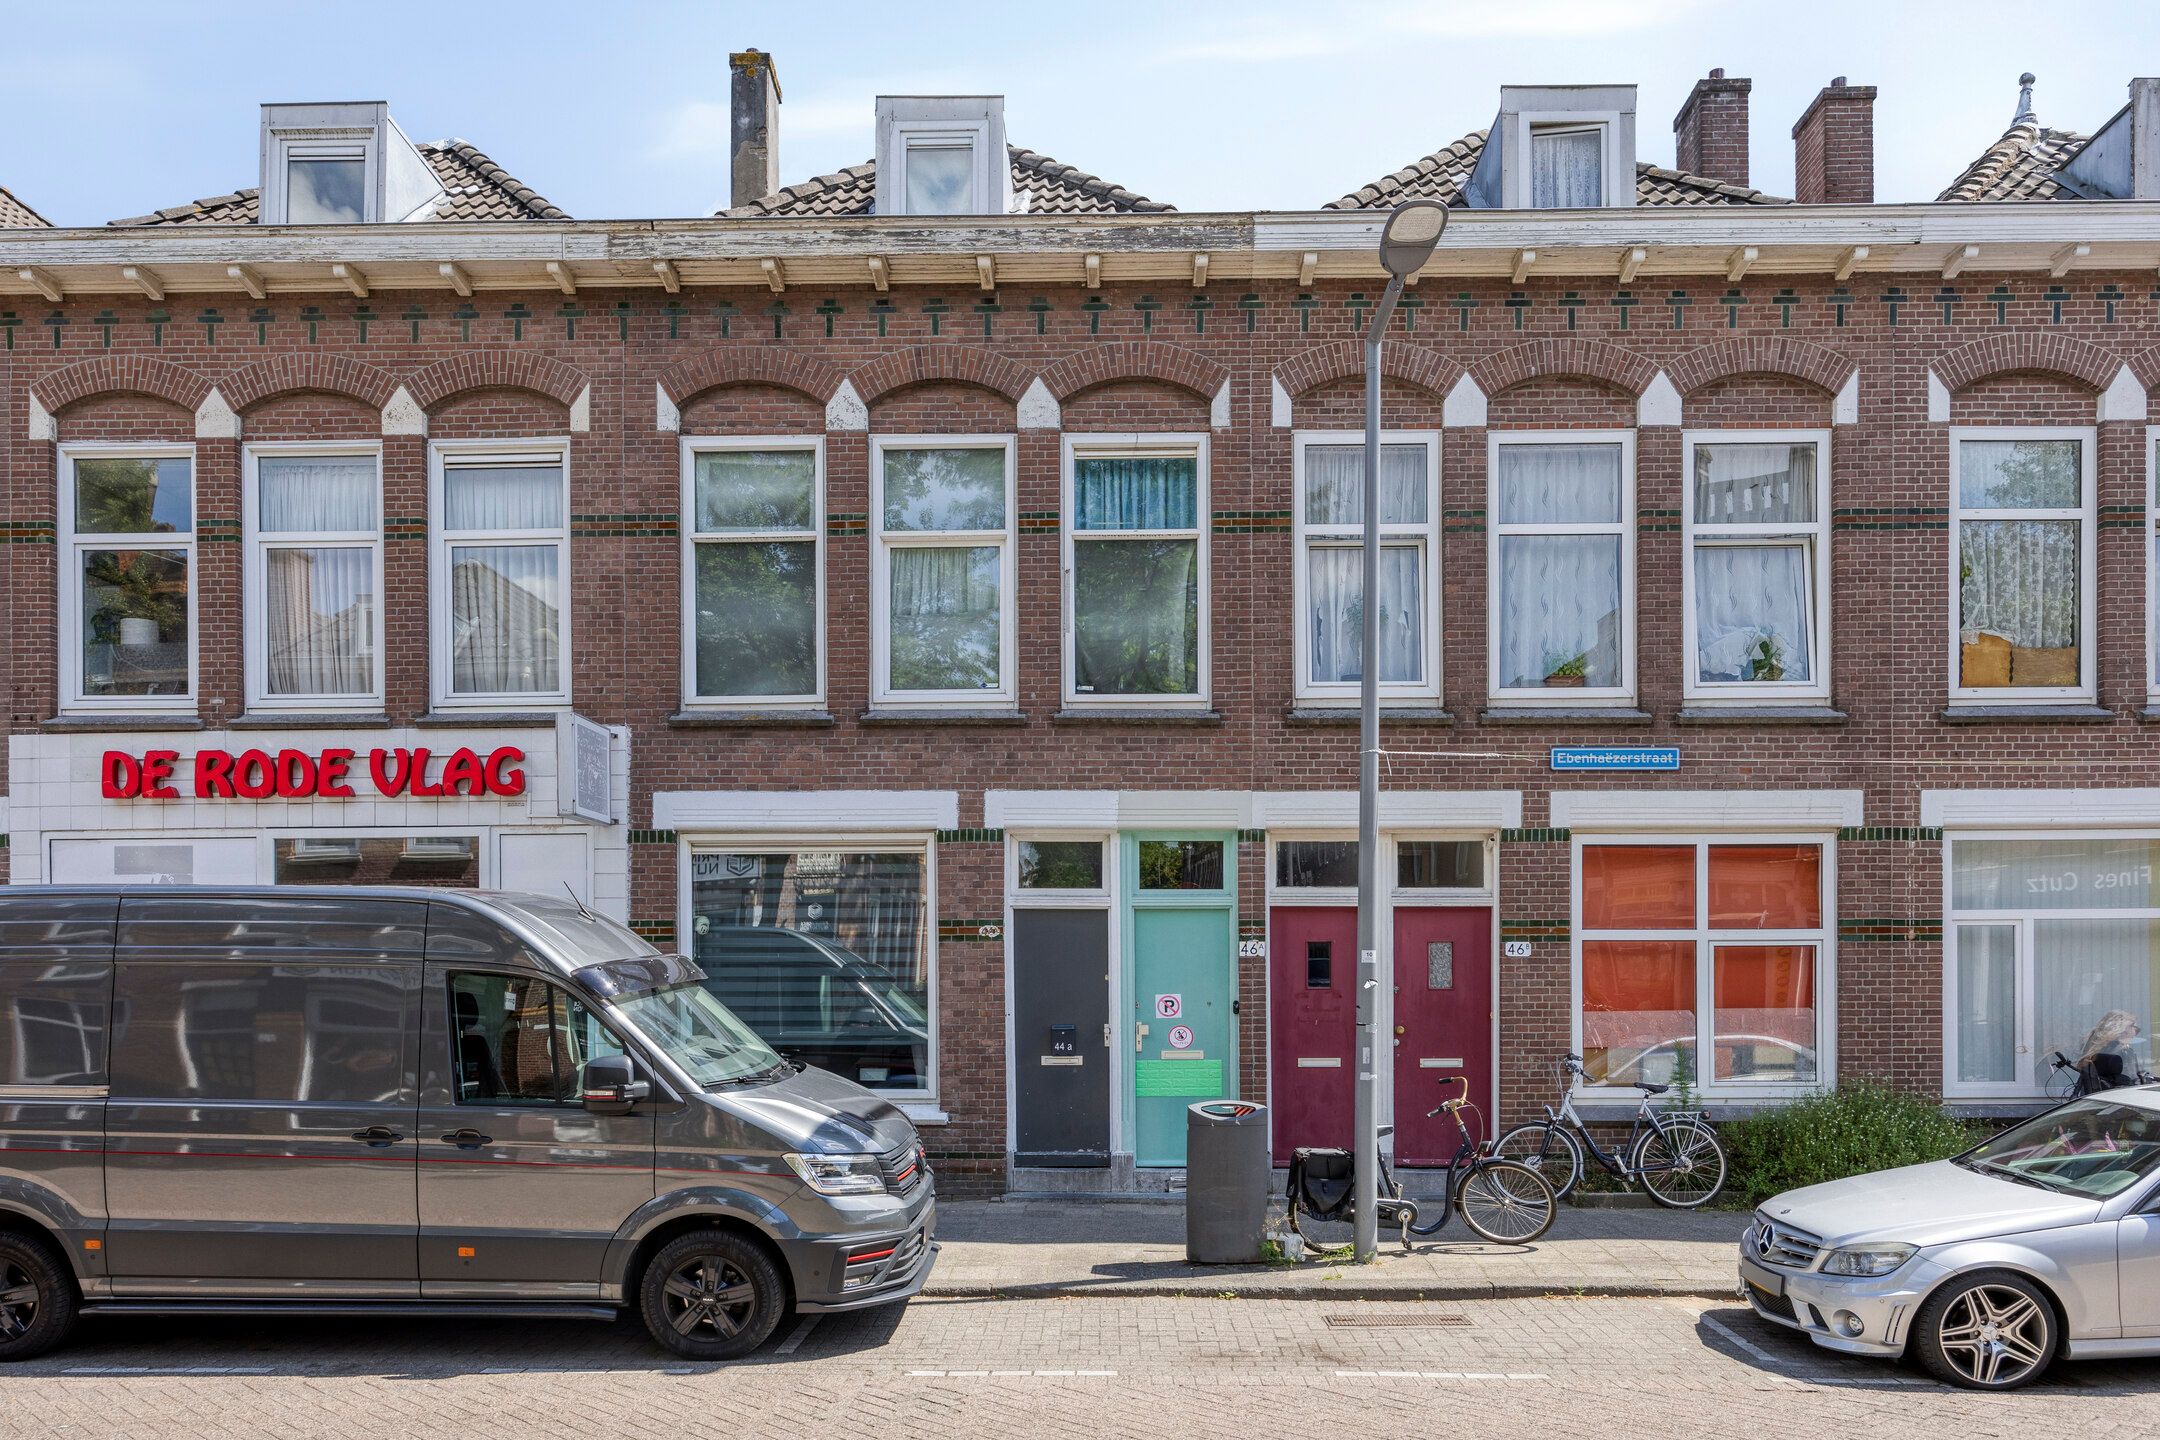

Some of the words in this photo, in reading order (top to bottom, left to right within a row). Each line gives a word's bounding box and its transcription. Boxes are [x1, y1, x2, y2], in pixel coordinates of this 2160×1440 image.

[1557, 752, 1673, 764] Ebenhaëzerstraat
[101, 749, 180, 799] DE
[194, 748, 356, 799] RODE
[369, 746, 526, 797] VLAG
[1508, 943, 1530, 955] 46B
[1054, 1042, 1065, 1051] 44
